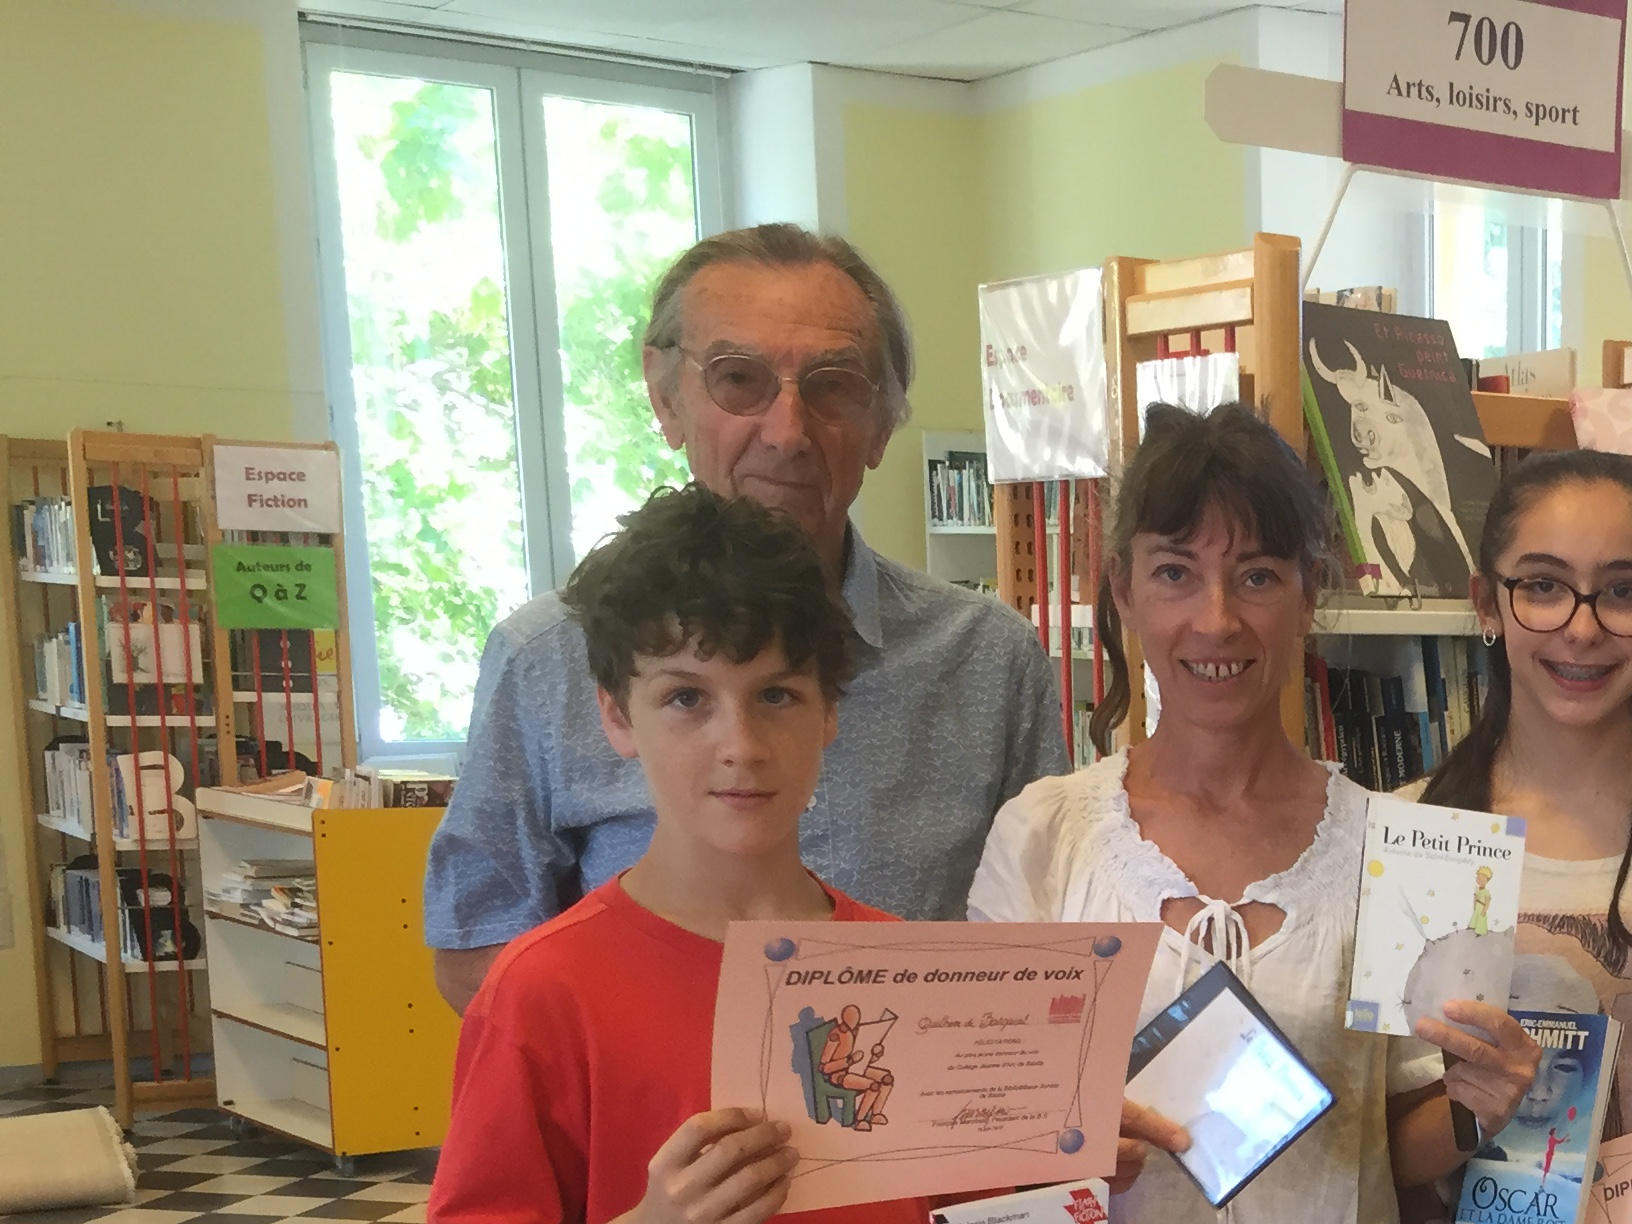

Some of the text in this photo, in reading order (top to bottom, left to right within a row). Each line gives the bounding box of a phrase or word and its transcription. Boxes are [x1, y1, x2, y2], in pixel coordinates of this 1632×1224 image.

[1448, 11, 1523, 71] 700
[1386, 73, 1579, 125] Arts, loisirs, sport
[244, 466, 306, 484] Espace
[247, 493, 308, 509] Fiction
[236, 559, 312, 572] Auteurs de
[250, 582, 307, 604] Q à Z
[1383, 826, 1406, 846] Le
[1412, 829, 1450, 852] Petit
[1457, 835, 1512, 861] Prince
[785, 965, 1085, 988] DIPLÔME de donneur de voix
[1460, 1208, 1475, 1221] ET
[1479, 1210, 1493, 1224] LA
